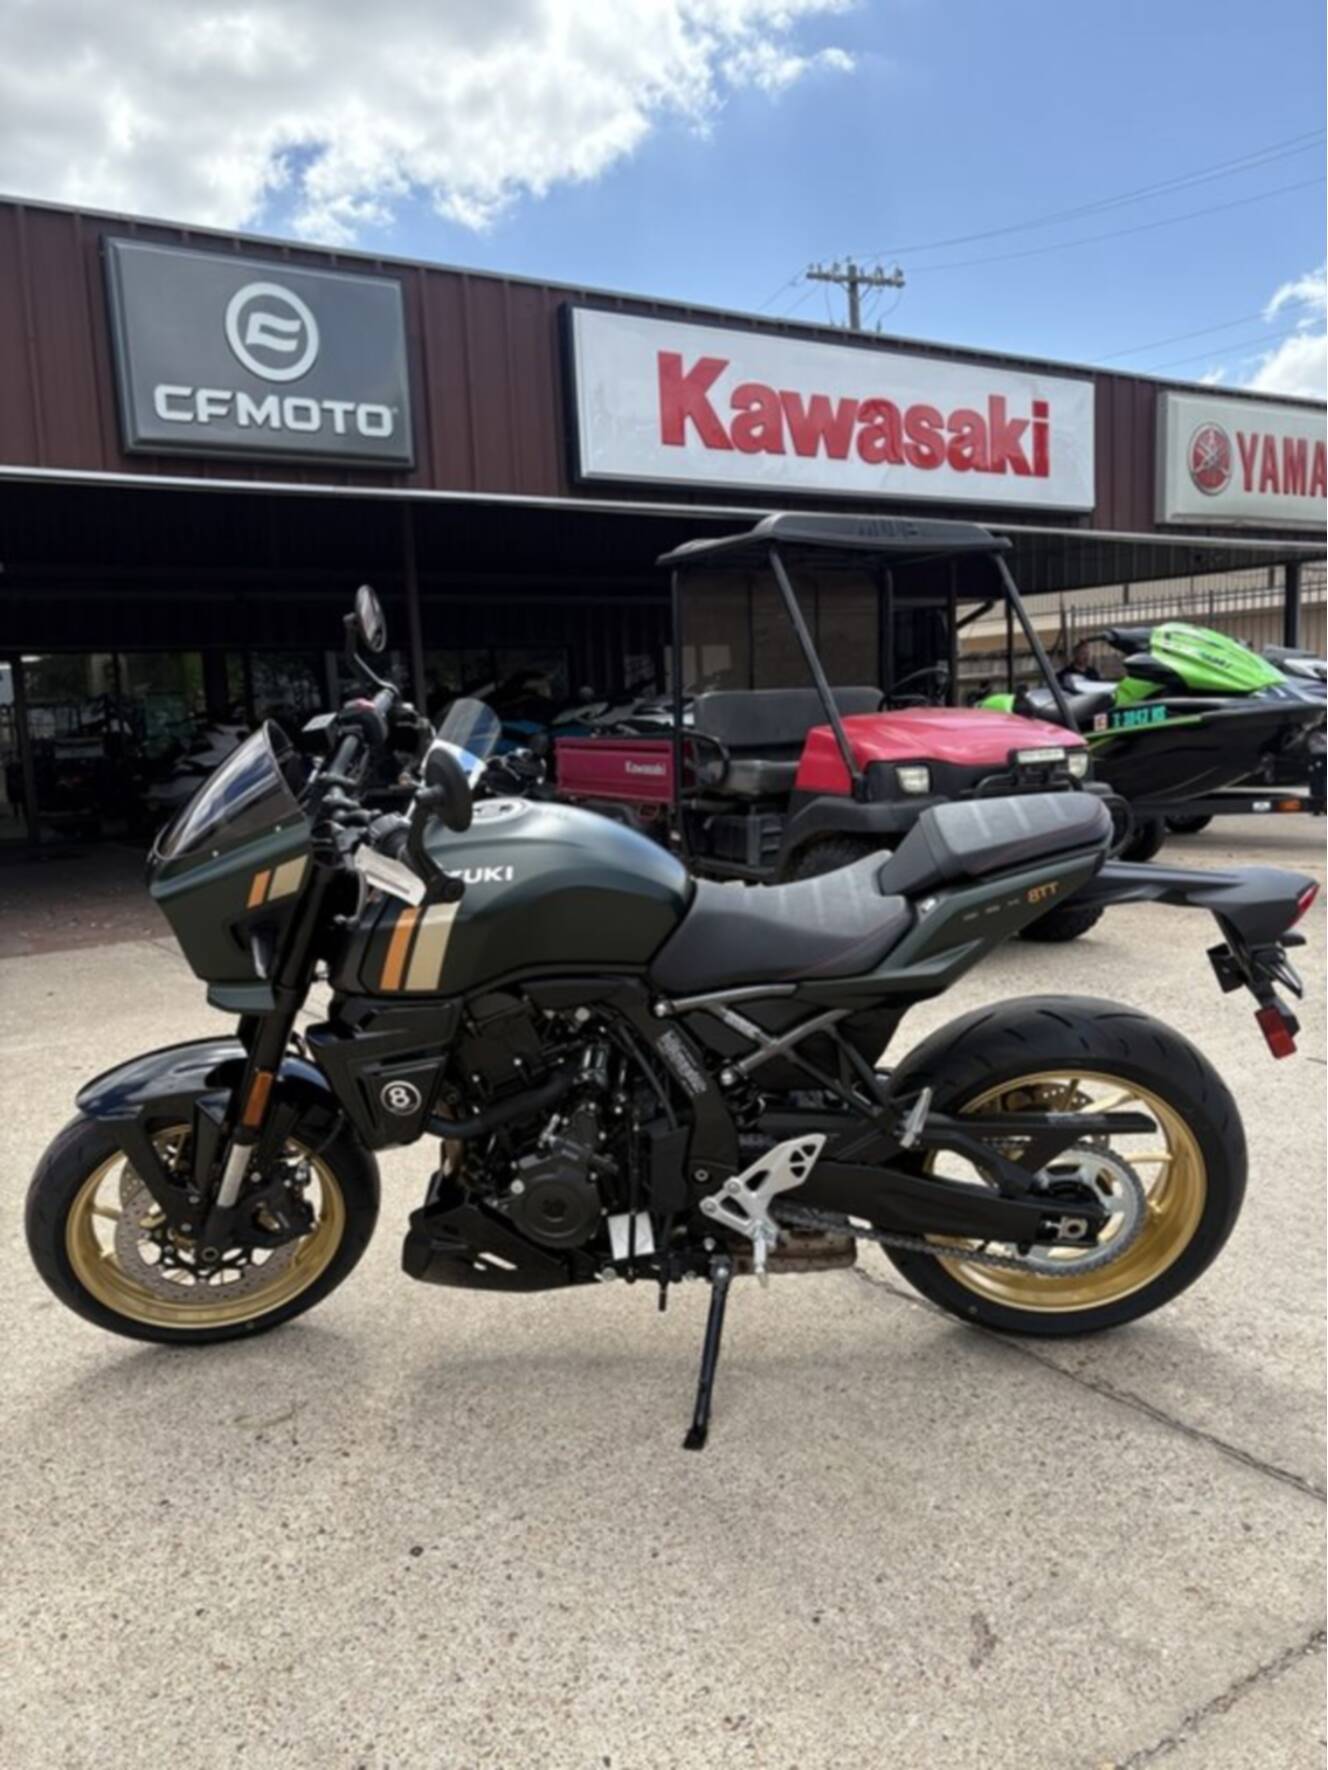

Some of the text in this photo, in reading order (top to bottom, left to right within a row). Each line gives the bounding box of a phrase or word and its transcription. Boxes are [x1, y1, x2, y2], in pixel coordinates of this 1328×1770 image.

[153, 384, 394, 437] CFMOTO
[657, 351, 1051, 478] Kawasaki
[388, 1086, 411, 1108] 8
